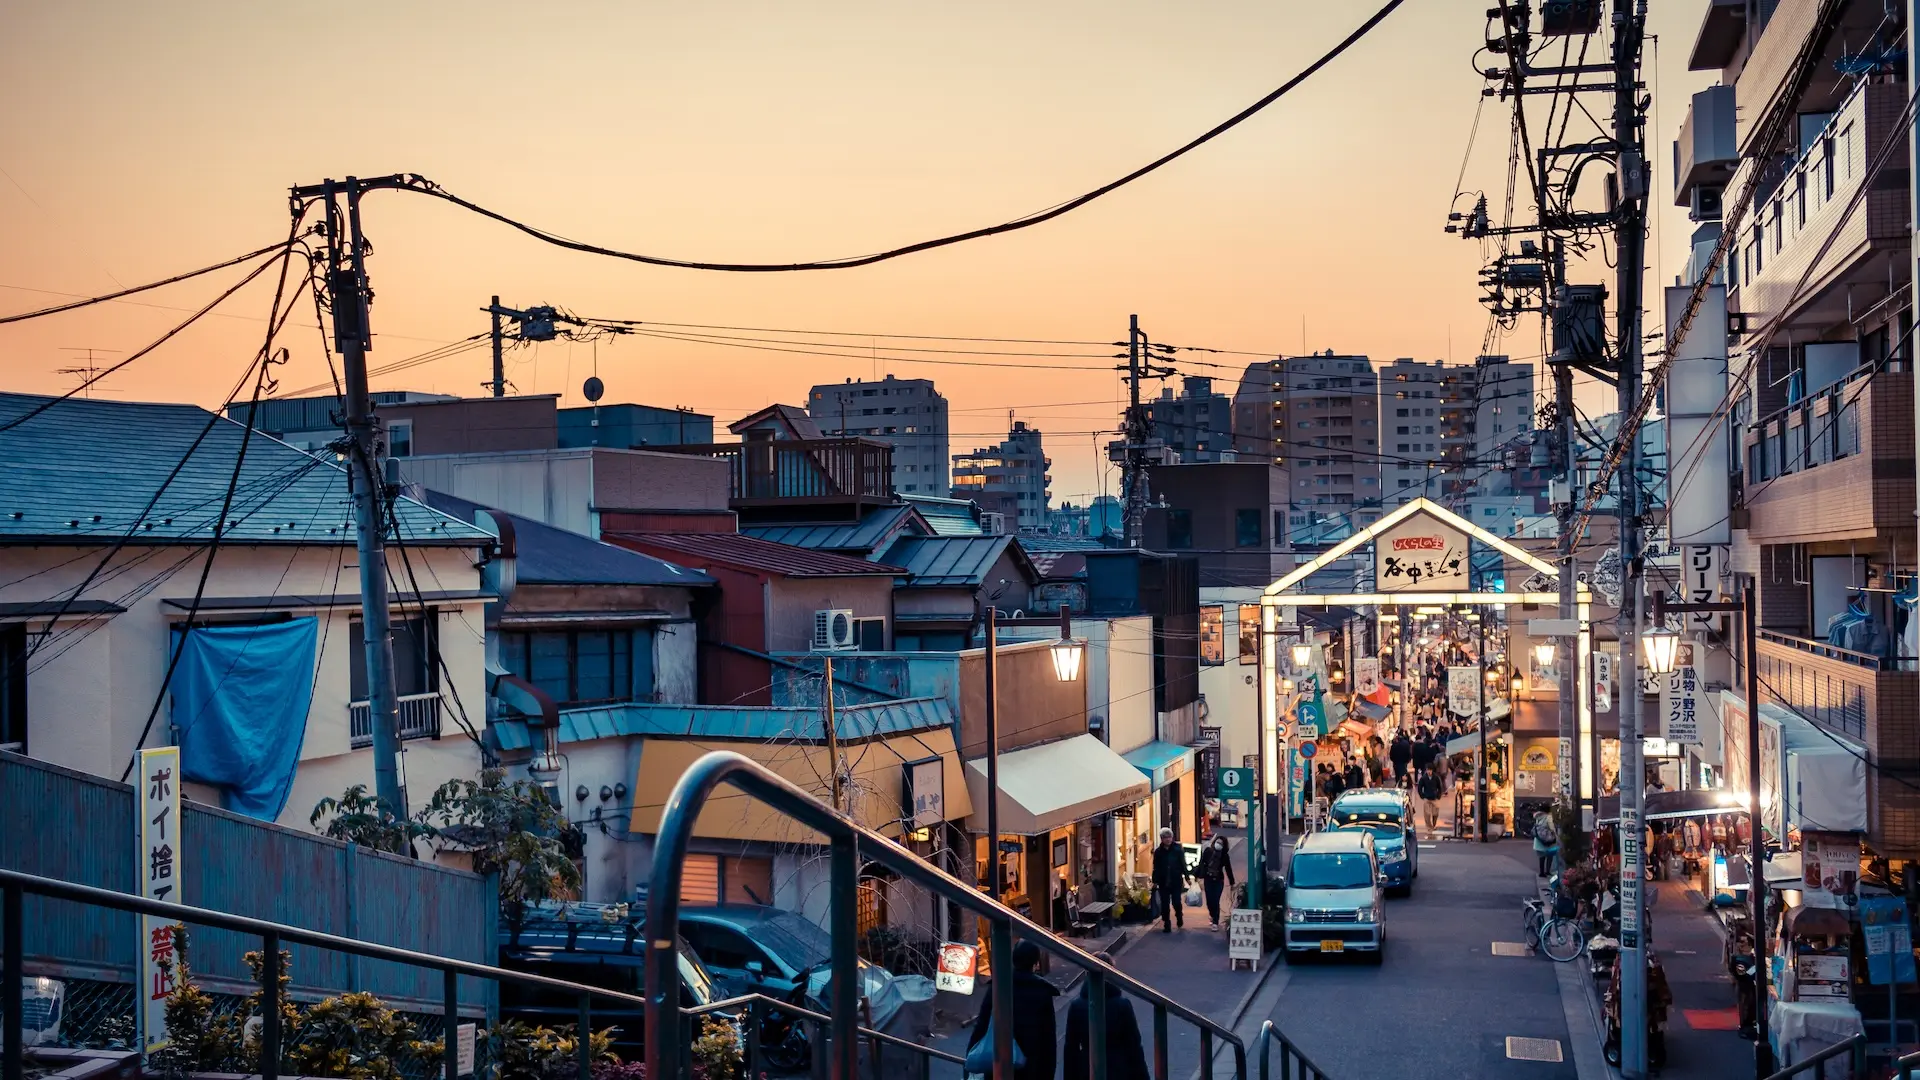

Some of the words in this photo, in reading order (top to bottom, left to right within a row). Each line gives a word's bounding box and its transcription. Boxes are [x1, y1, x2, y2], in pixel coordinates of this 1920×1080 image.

[1393, 534, 1444, 550] ひぐらしの里
[1384, 546, 1463, 584] 谷中ぎんざ
